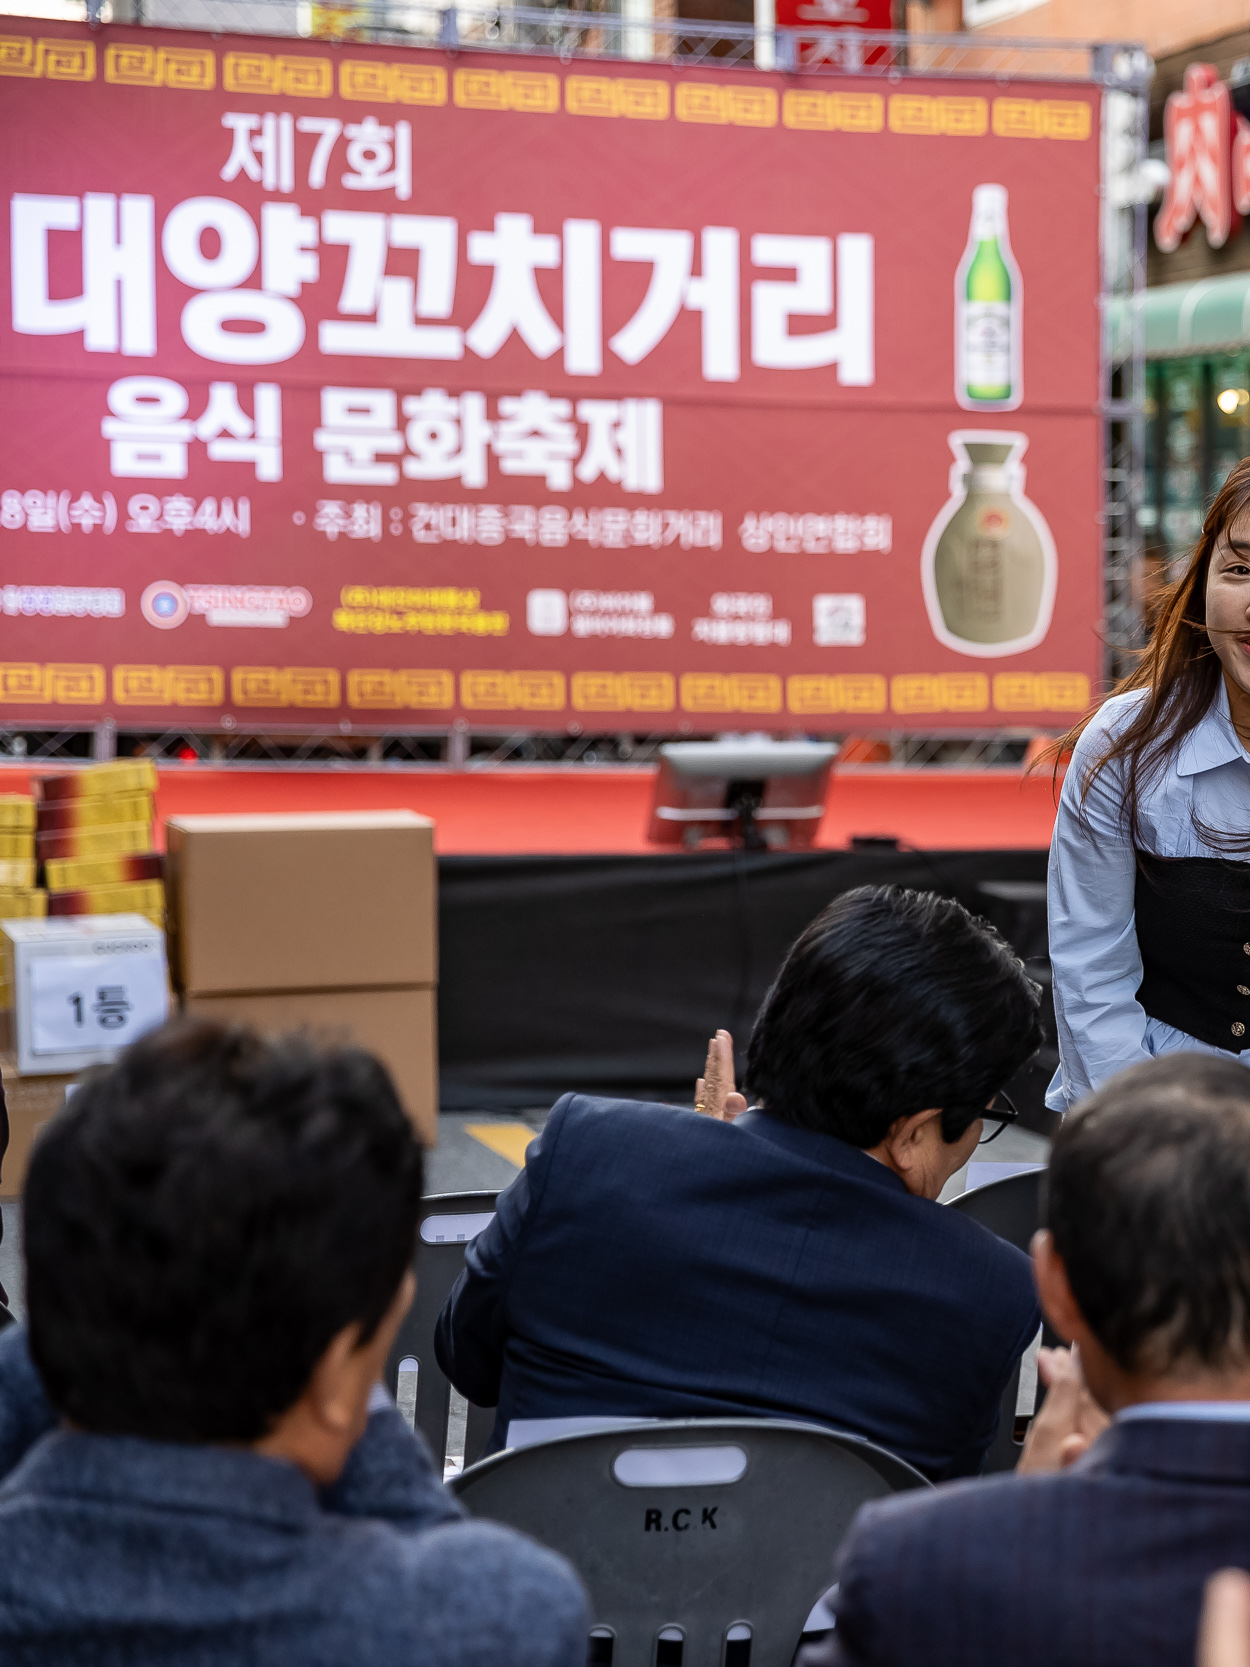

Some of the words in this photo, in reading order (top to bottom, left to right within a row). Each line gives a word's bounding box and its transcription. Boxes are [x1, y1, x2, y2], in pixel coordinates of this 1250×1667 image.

[220, 111, 413, 200] 제7회
[10, 191, 876, 386] 대양꼬치거리
[101, 374, 283, 483] 음식
[313, 385, 664, 495] 문화축제
[125, 492, 251, 539] 오후4시
[313, 499, 383, 542] 주최
[66, 984, 136, 1030] 1등
